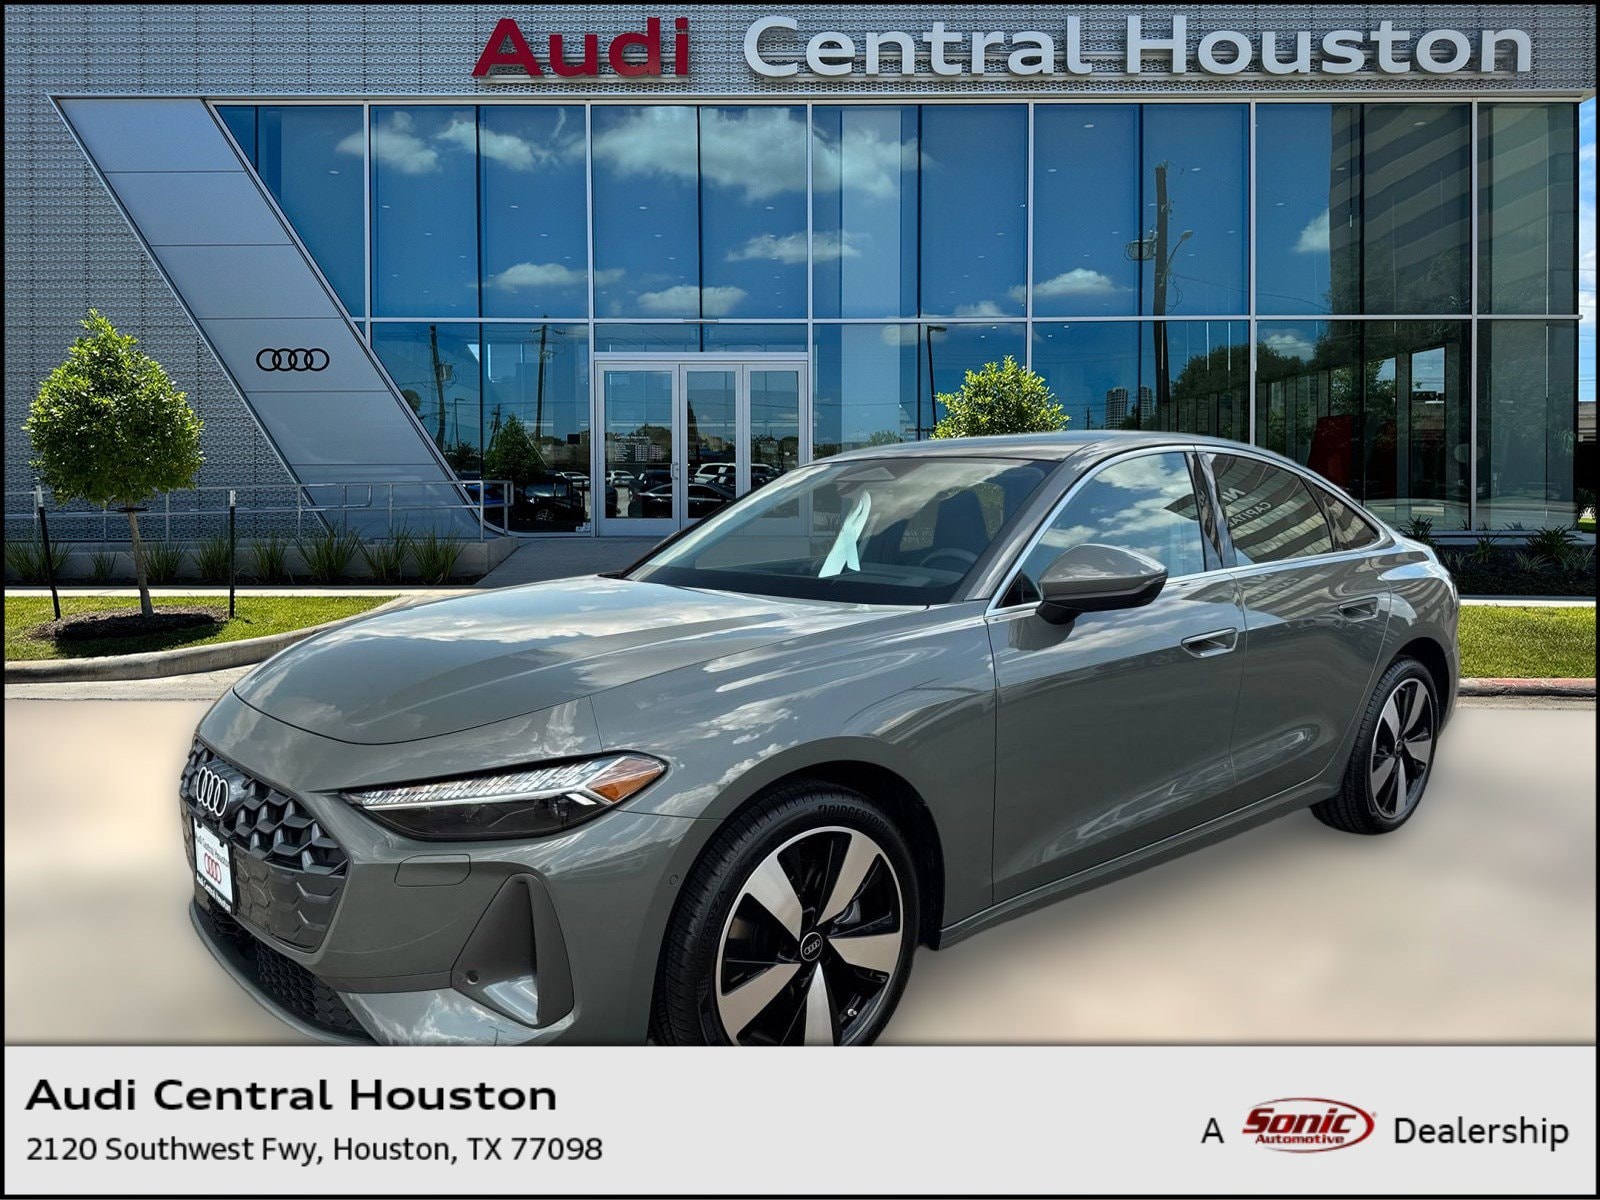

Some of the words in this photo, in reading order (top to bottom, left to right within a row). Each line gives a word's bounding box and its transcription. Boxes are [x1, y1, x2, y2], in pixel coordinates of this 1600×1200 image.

[471, 16, 689, 78] Audi
[743, 15, 1093, 77] Central
[1126, 14, 1533, 75] Houston
